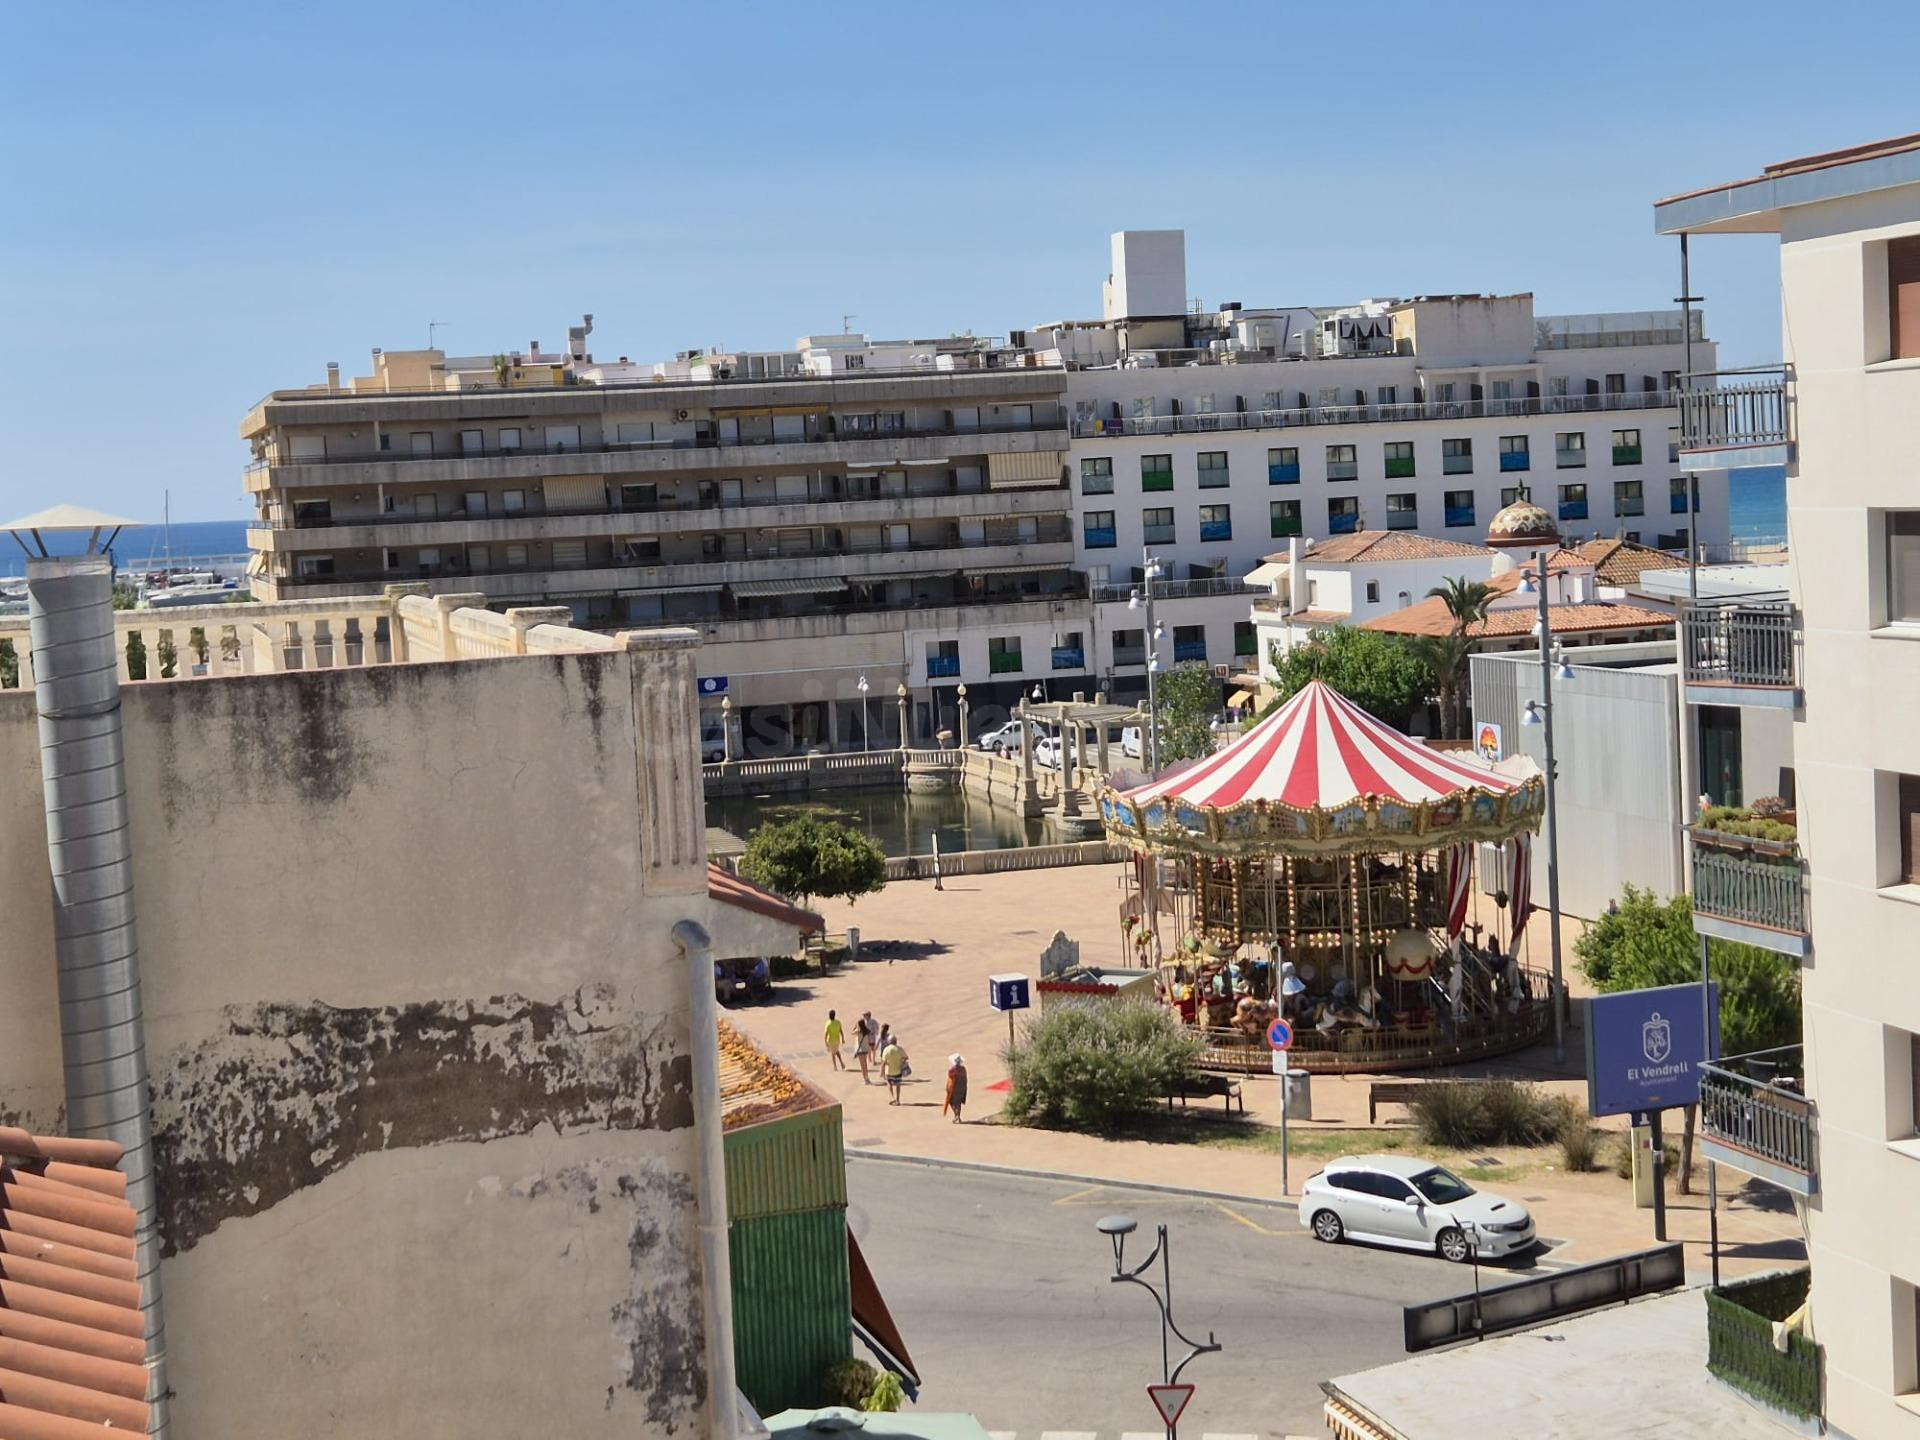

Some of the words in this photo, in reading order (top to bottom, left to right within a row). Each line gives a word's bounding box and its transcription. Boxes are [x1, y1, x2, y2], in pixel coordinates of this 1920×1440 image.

[1010, 984, 1020, 1005] i
[1628, 1068, 1639, 1080] El
[1641, 1061, 1688, 1078] Vendrell
